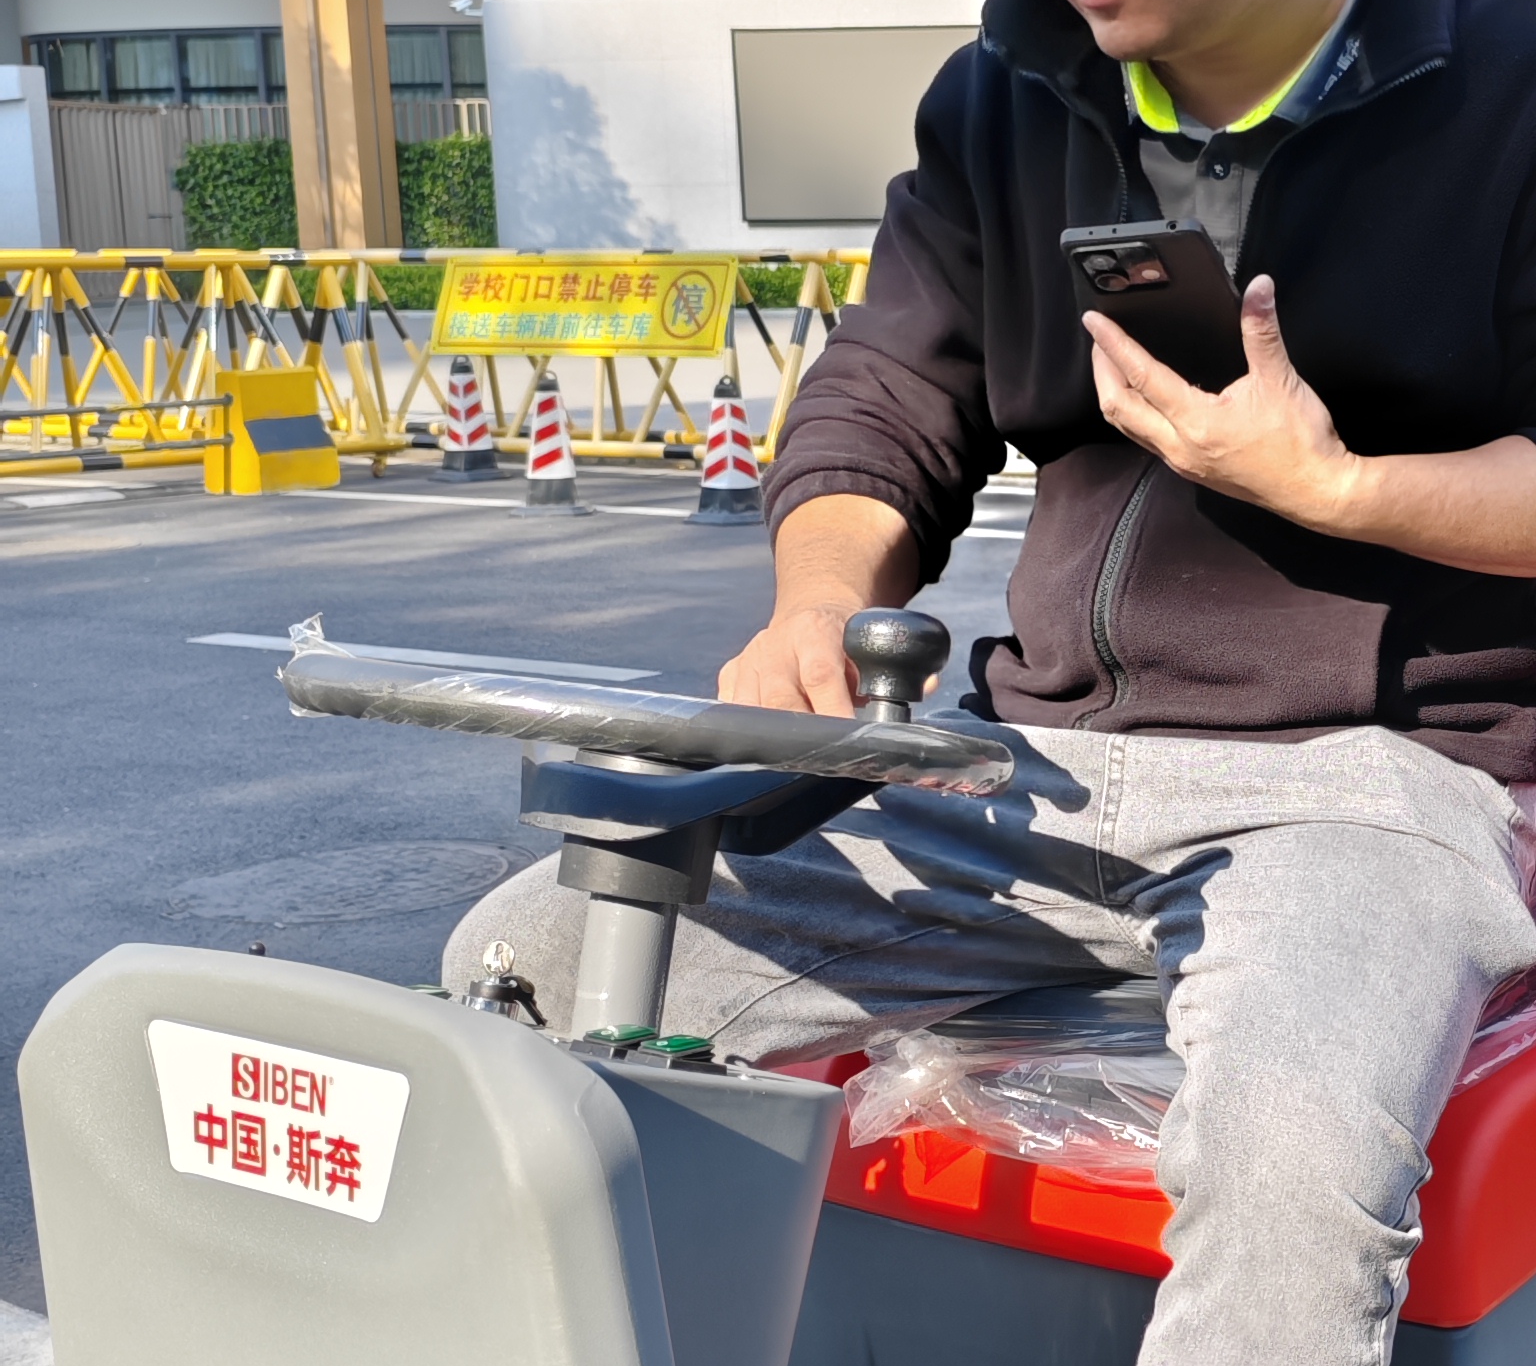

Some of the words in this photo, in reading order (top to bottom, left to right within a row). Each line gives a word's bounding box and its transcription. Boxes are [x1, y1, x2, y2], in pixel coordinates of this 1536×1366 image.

[457, 272, 660, 304] 学校门口禁止停车
[448, 311, 653, 341] 接送车辆请前往车库
[231, 1052, 327, 1117] SIBEN
